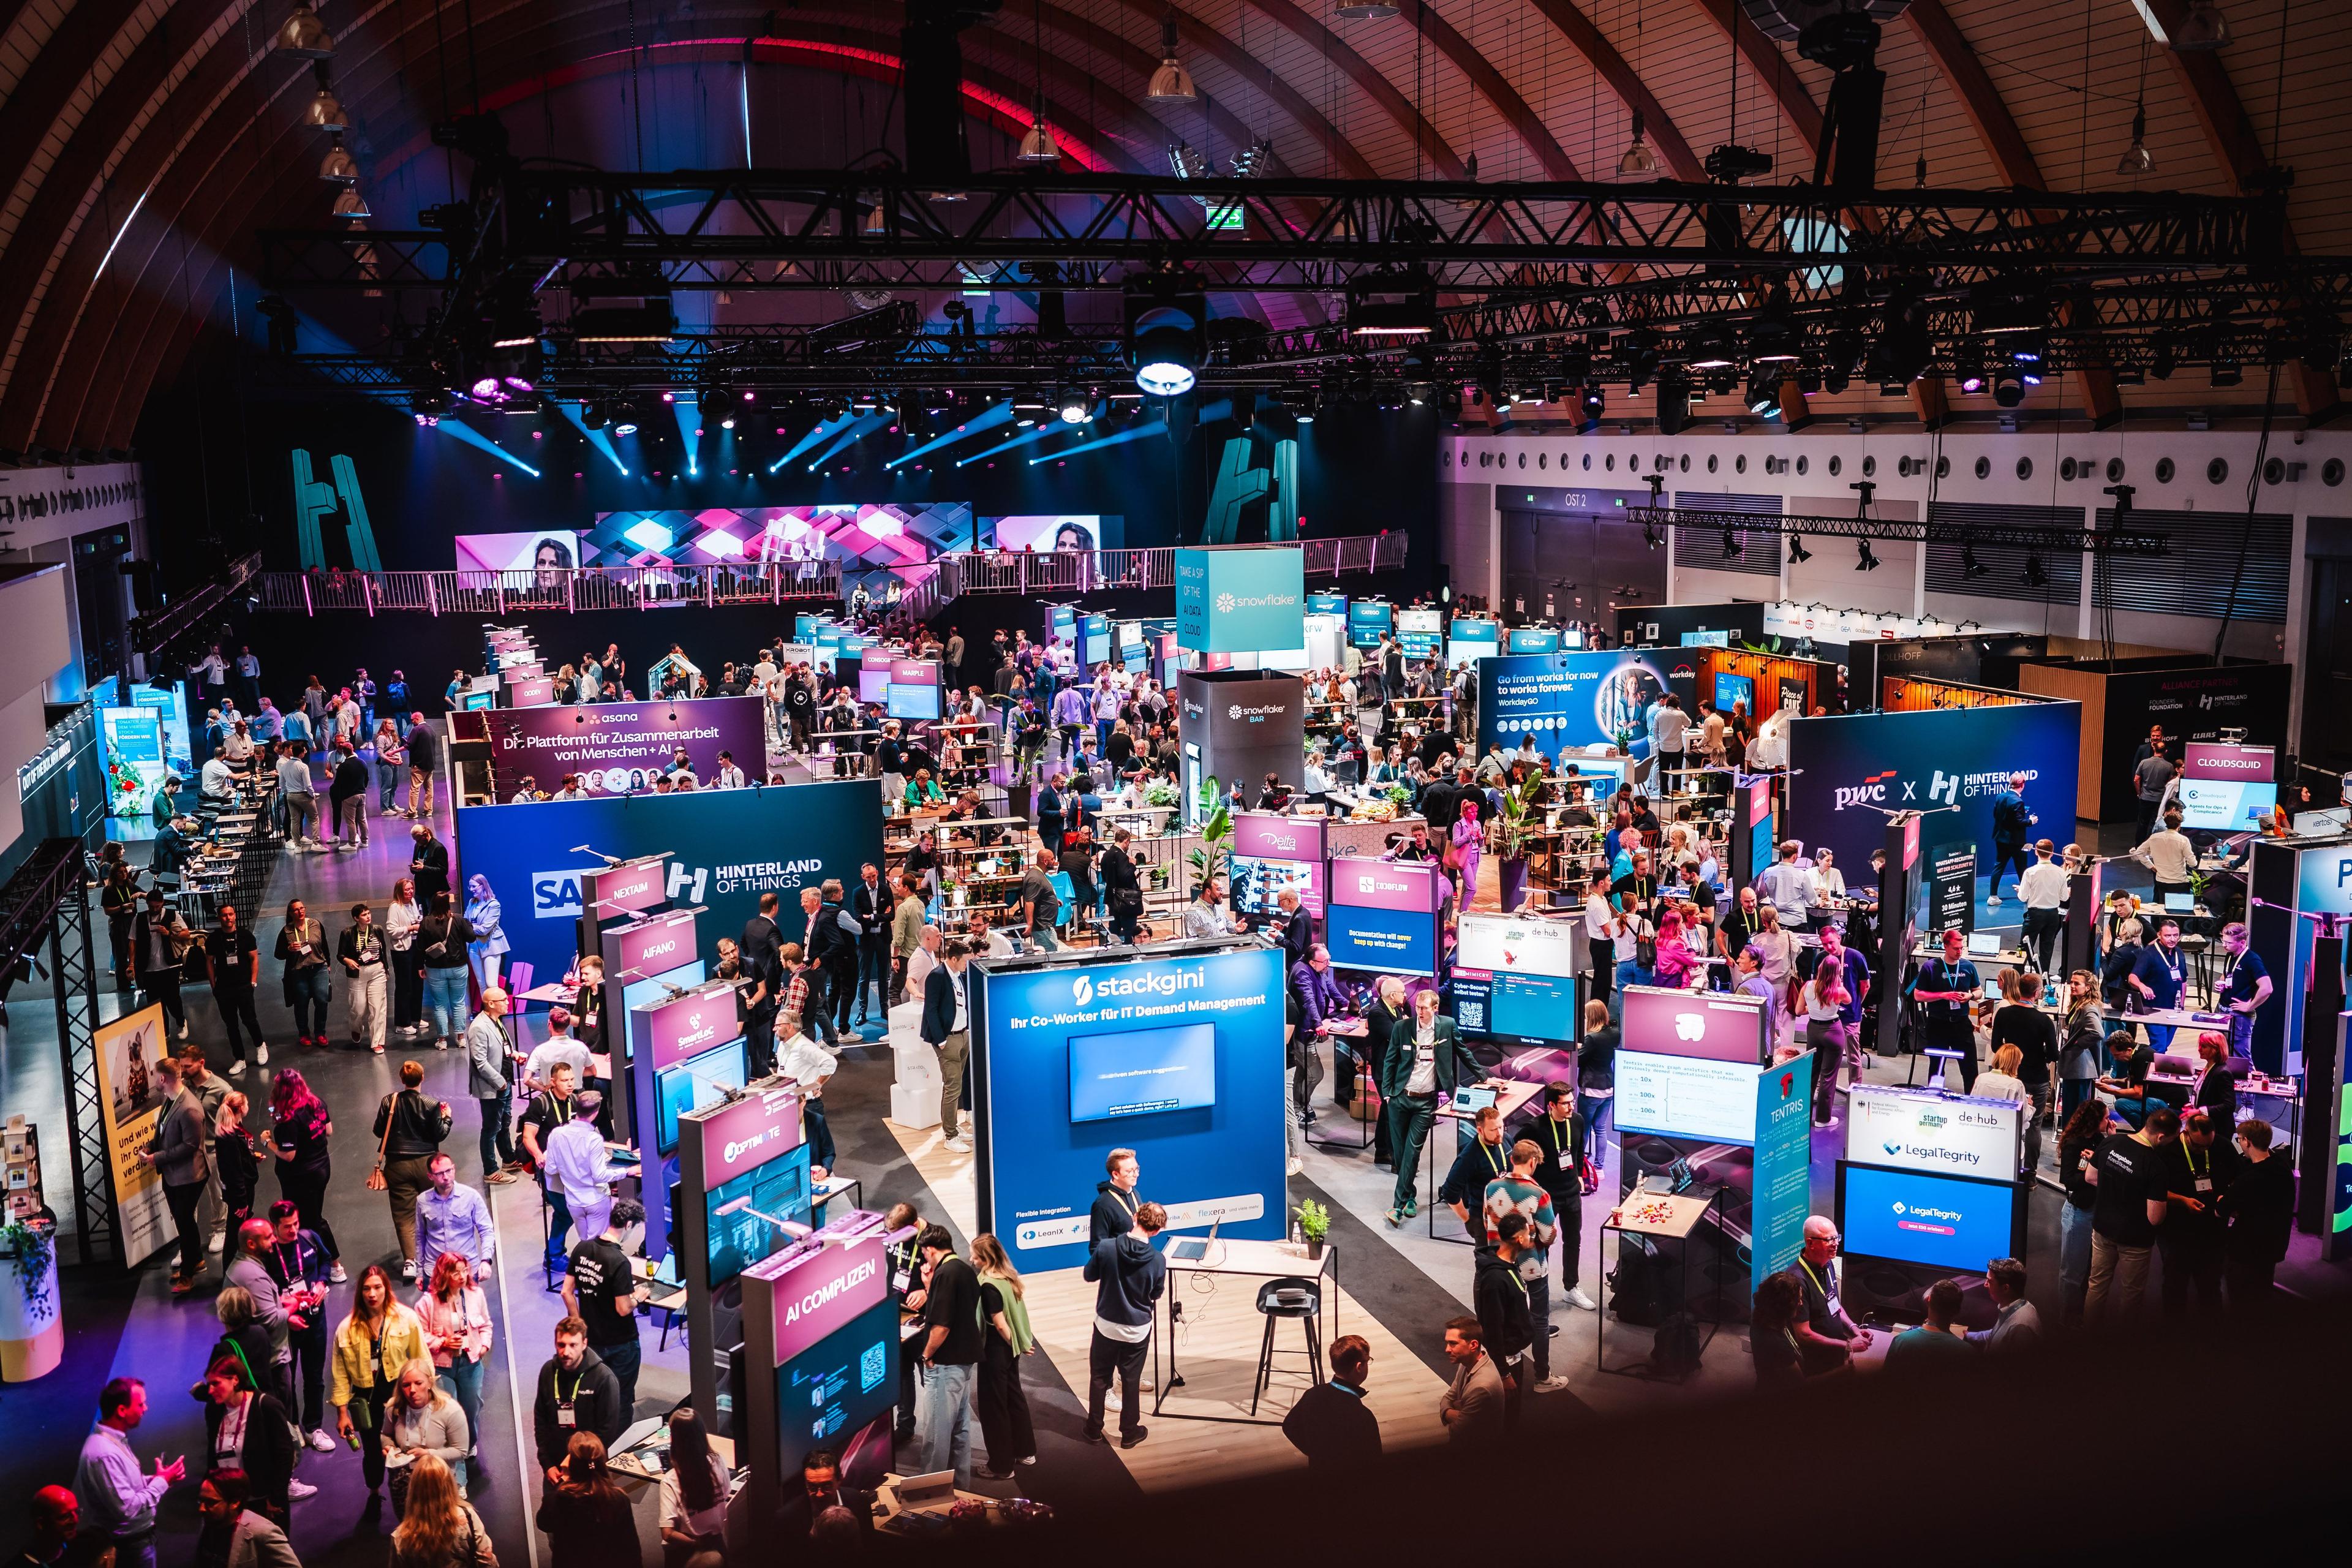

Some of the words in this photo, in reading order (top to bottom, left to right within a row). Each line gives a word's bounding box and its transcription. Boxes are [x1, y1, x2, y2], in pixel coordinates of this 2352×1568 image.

[1565, 493, 1579, 507] OST
[1581, 494, 1586, 507] 2
[1180, 566, 1191, 577] TAKE
[1192, 568, 1196, 578] A
[1183, 586, 1190, 596] OF
[1191, 587, 1200, 598] THE
[1237, 594, 1294, 606] snowflake
[1184, 606, 1188, 614] AI
[1189, 606, 1201, 617] DATA
[1185, 624, 1200, 636] CLOUD
[1498, 676, 1511, 684] Go
[1512, 674, 1534, 683] from
[1536, 673, 1564, 682] works
[1565, 671, 1578, 680] for
[2161, 680, 2200, 691] ALLIANCE
[2202, 678, 2239, 688] PARTNER
[1498, 685, 1508, 695] to
[1509, 684, 1537, 694] works
[1539, 683, 1573, 693] forever.
[1781, 687, 1796, 698] Piece
[1796, 691, 1803, 703] of
[1498, 698, 1539, 706] WorkdayGO
[1243, 704, 1283, 715] snowflake
[601, 713, 638, 723] asana
[527, 734, 589, 748] Plattform
[590, 732, 609, 745] für
[611, 726, 719, 743] Zusammenarbeit
[554, 750, 579, 761] von
[582, 747, 647, 759] Menschen
[658, 745, 671, 755] AI
[22, 773, 31, 791] OUT
[59, 739, 70, 762] AWARD
[2198, 758, 2261, 769] CLOUDSQUID
[1964, 770, 2038, 785] HINTERLND
[1964, 786, 1980, 797] OF
[1982, 783, 2014, 796] THIN
[1834, 785, 1886, 811] pwc
[715, 859, 822, 879] HINTERLAND
[613, 882, 648, 900] NEXTAIM
[717, 879, 739, 893] OF
[742, 875, 801, 892] THINGS
[535, 878, 582, 909] SA
[1948, 901, 1967, 910] Minuten
[1349, 929, 1386, 939] Documentation
[642, 940, 676, 960] AIFANO
[1097, 966, 1204, 997] stackgini
[1454, 983, 1490, 992] Cyber-Security
[1011, 1017, 1028, 1029] Ihr
[1030, 1010, 1098, 1027] Co-Worker
[1100, 1008, 1118, 1021] für
[1121, 1006, 1133, 1018] IT
[1136, 1003, 1185, 1017] Demand
[1188, 994, 1266, 1015] Management
[1672, 1071, 1714, 1079] computationally
[1771, 1099, 1803, 1124] TENTRIS
[1923, 1114, 1947, 1124] startup
[119, 1132, 134, 1149] Und
[135, 1126, 148, 1139] wie
[121, 1151, 131, 1164] ihr
[1906, 1144, 1980, 1165] LegalTegrity
[2109, 1150, 2132, 1166] Ausgaben
[2108, 1155, 2133, 1174] Kreditkarten
[1016, 1208, 1038, 1218] Flexible
[1039, 1205, 1071, 1216] Integration
[1198, 1207, 1226, 1217] flexera
[1910, 1205, 1962, 1221] LegalTegrity
[1038, 1229, 1064, 1237] LeanIX
[785, 1303, 799, 1325] AI
[802, 1258, 876, 1314] COMPLIZEN
